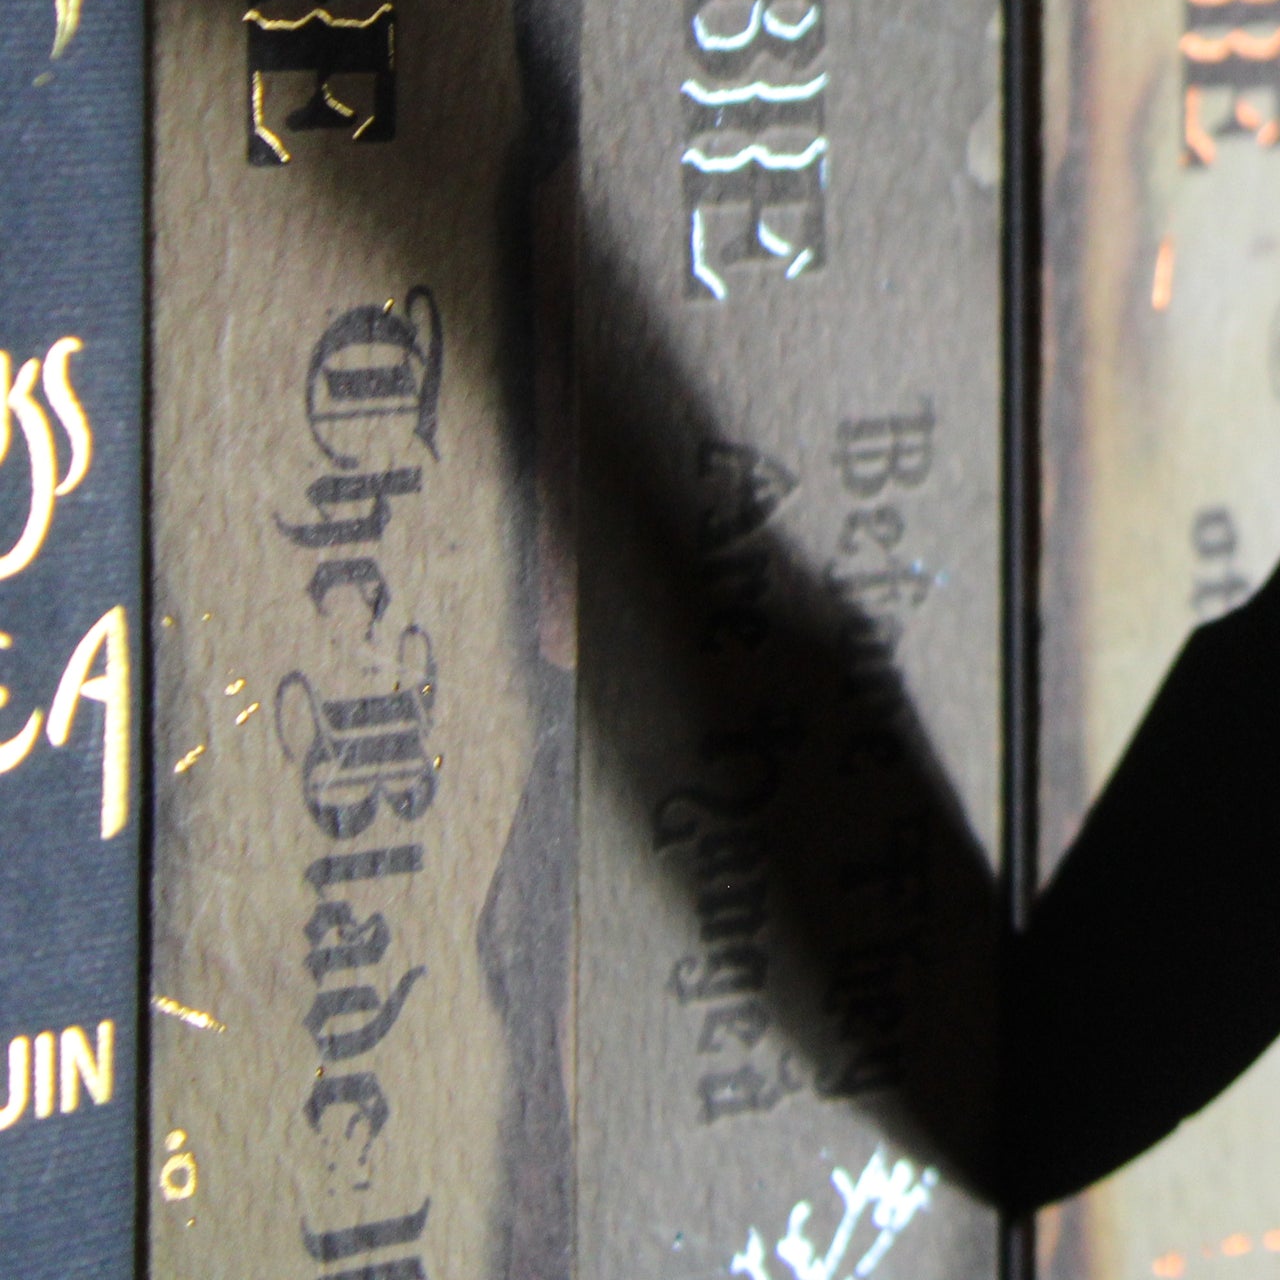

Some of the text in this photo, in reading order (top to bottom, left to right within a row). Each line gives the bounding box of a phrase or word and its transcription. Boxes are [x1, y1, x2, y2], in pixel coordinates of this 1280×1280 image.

[273, 285, 444, 632] The
[812, 398, 936, 1103] Before They
[275, 624, 446, 1160] Blade
[653, 440, 807, 1126] Are Hanged
